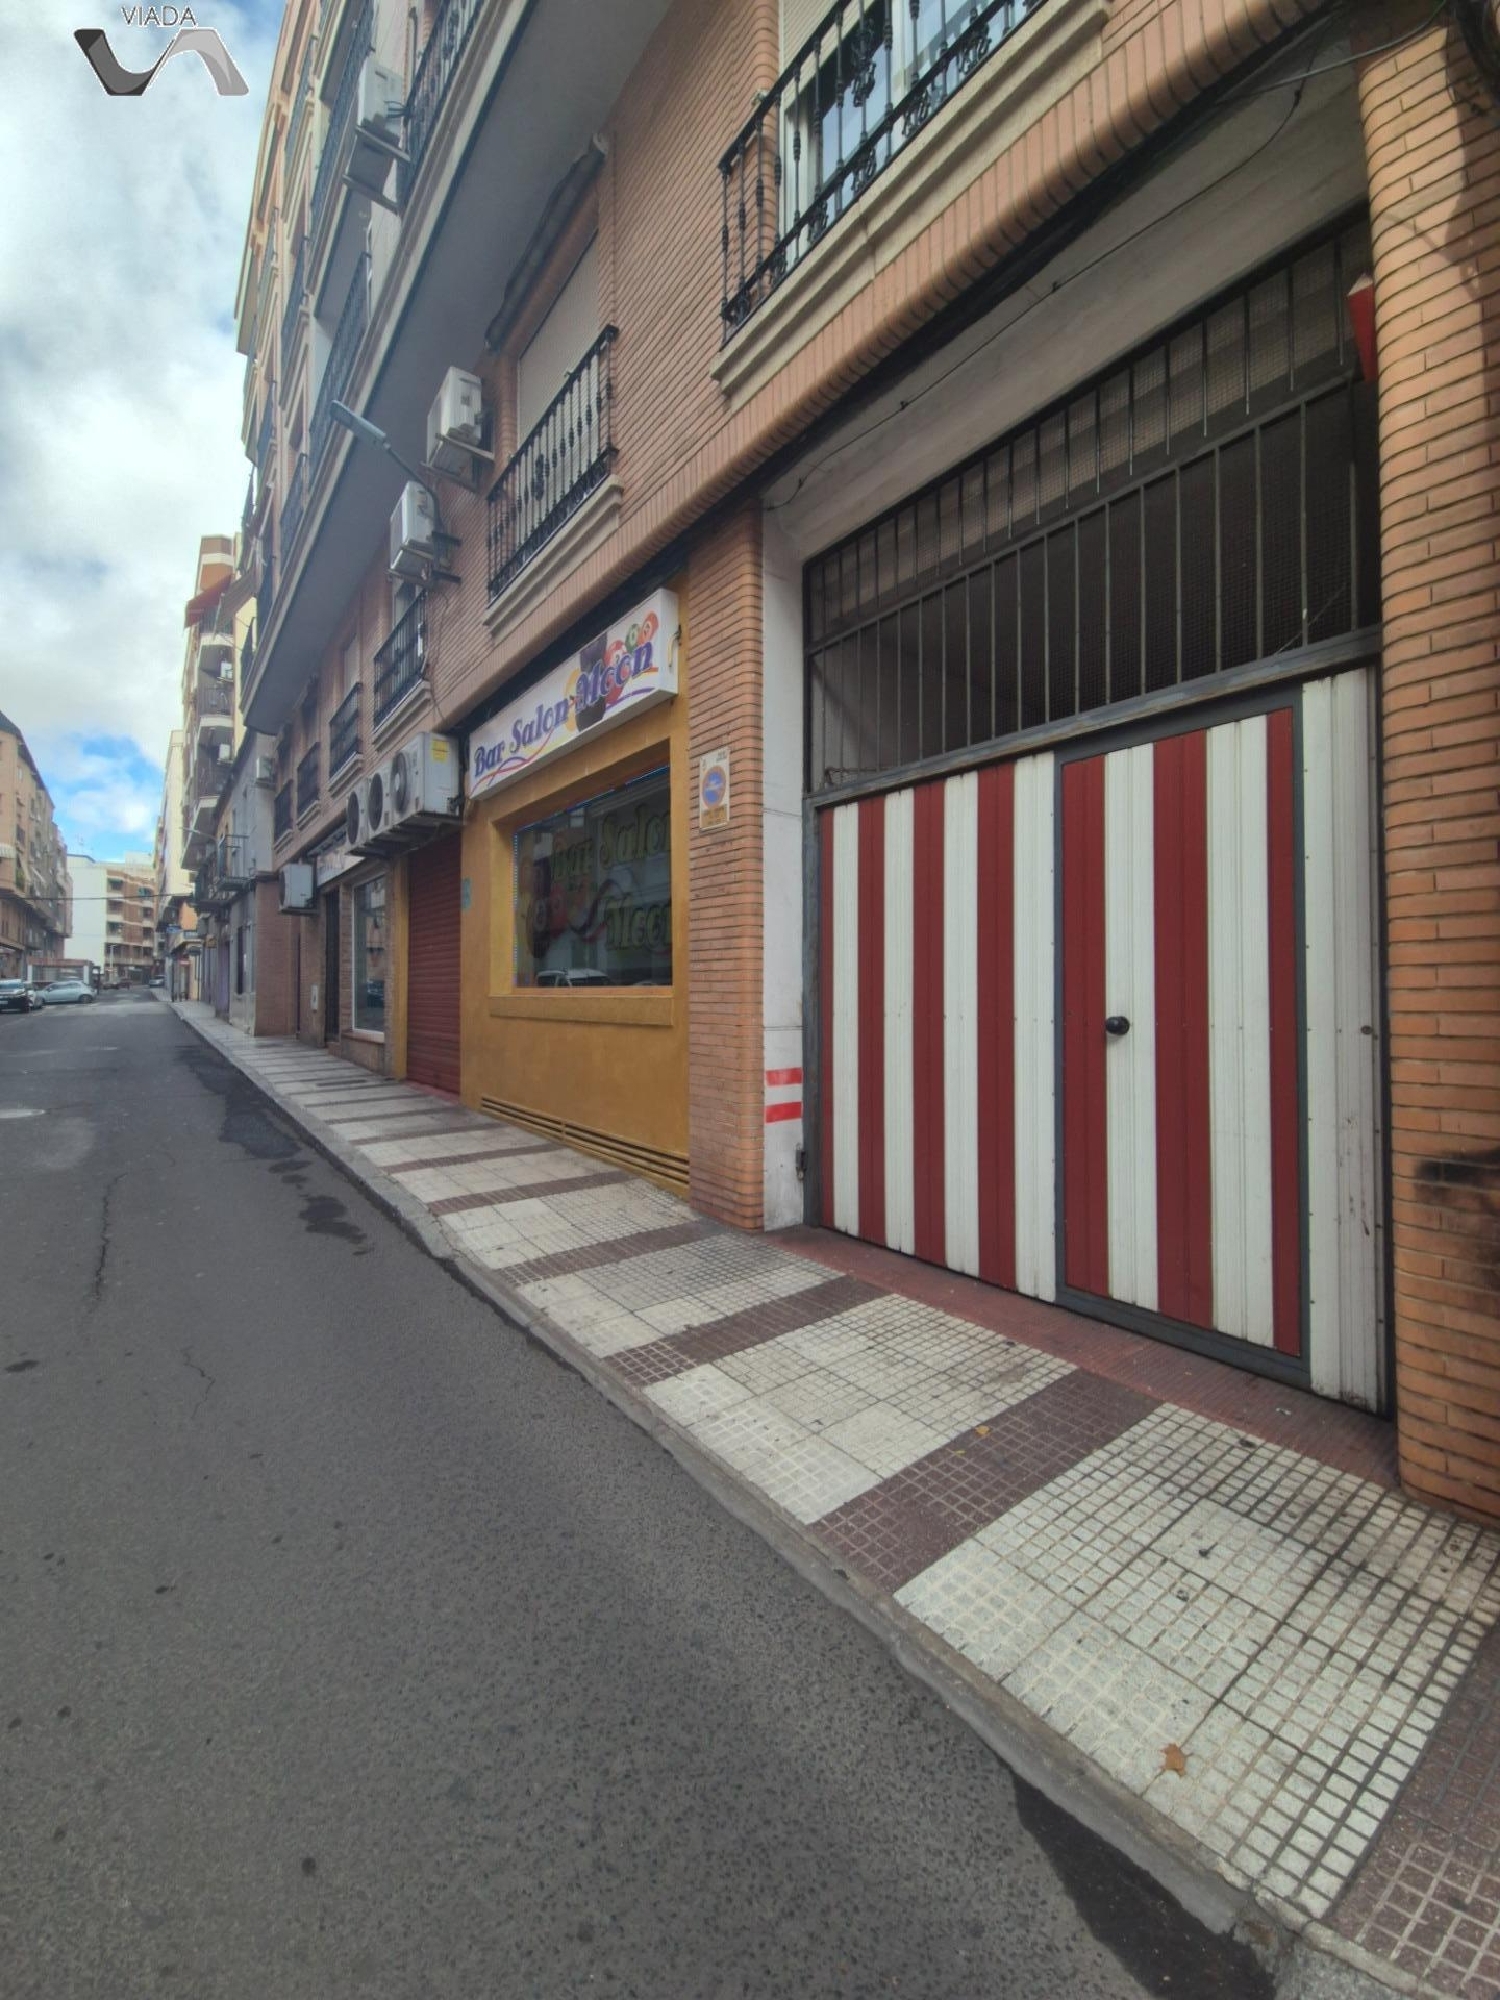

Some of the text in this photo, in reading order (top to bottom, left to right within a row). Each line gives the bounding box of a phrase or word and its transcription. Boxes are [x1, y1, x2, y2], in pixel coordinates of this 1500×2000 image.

[473, 743, 504, 777] Bar
[509, 699, 570, 753] Salon
[573, 641, 653, 712] Moon
